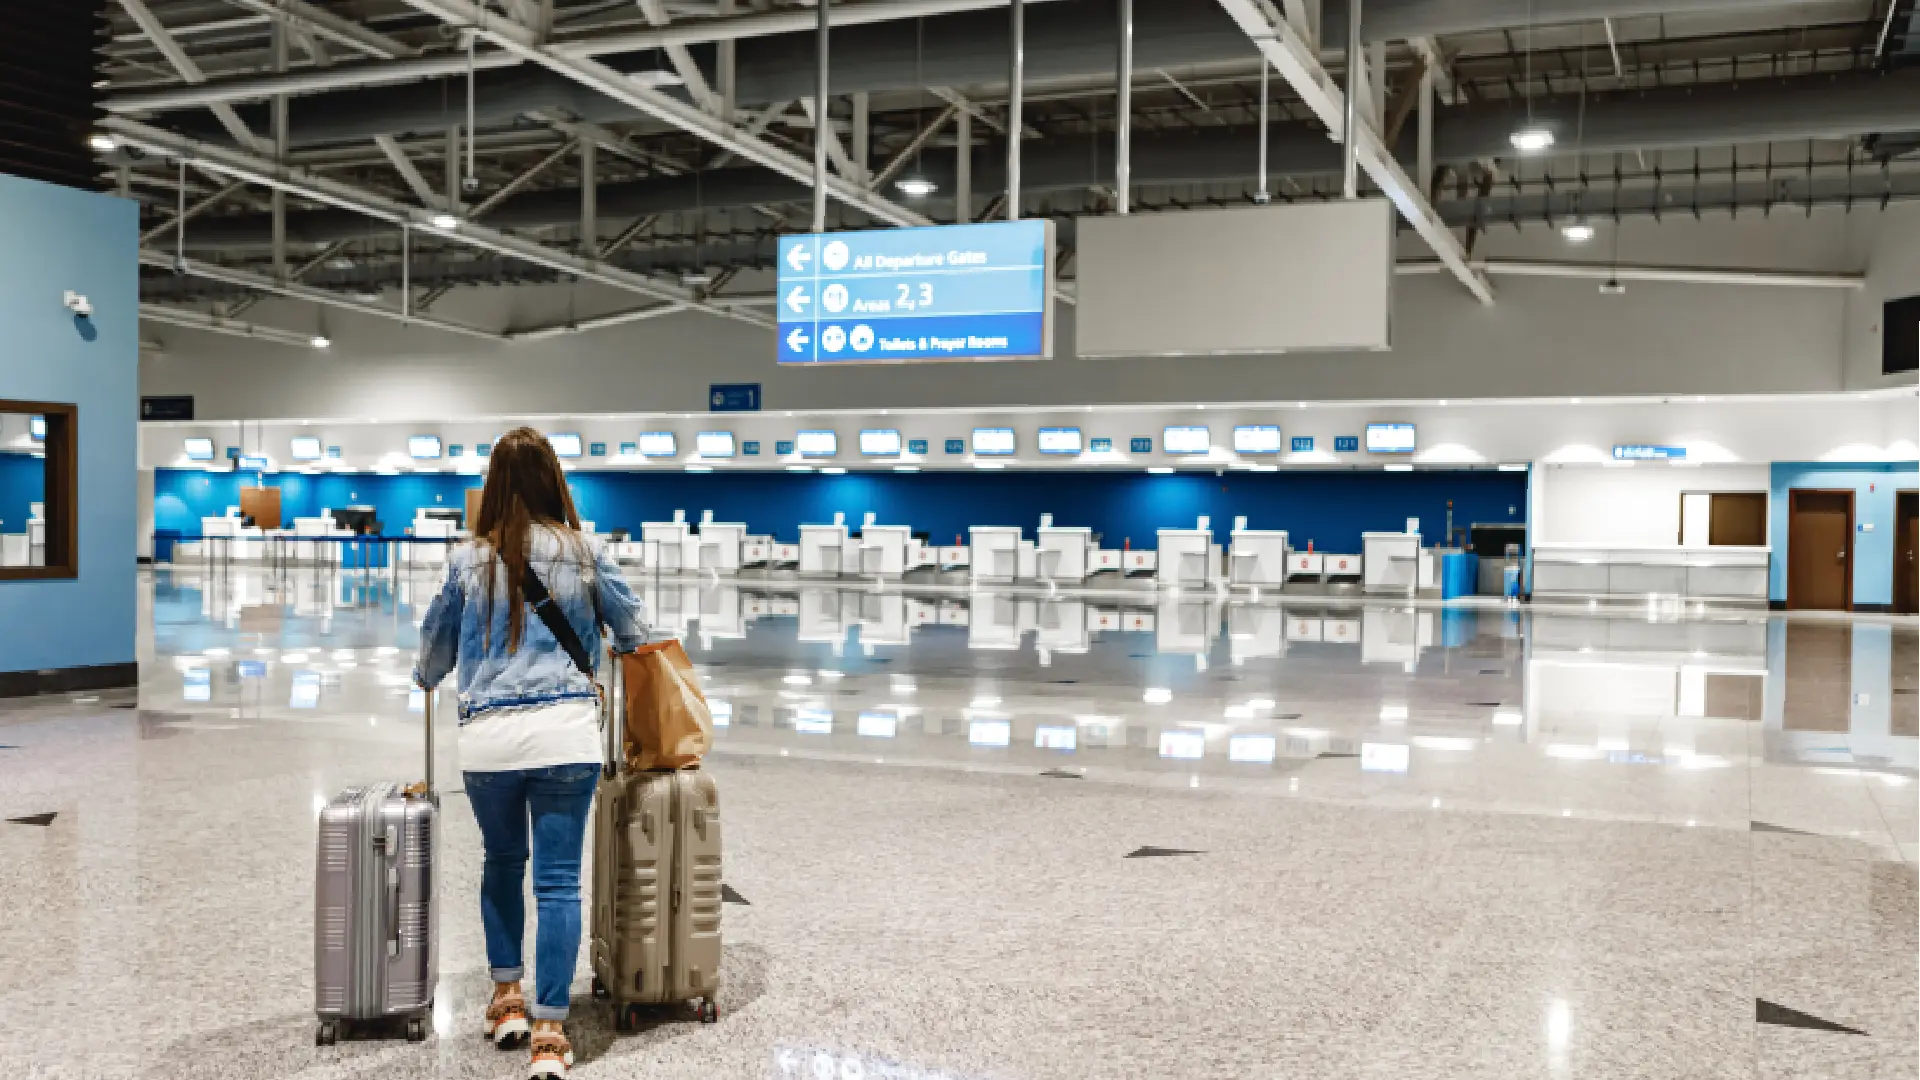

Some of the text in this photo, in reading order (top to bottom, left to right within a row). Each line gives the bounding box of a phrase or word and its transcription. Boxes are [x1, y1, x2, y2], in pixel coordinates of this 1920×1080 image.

[853, 250, 987, 272] All Departure Gates
[852, 298, 891, 312] Areas
[879, 338, 916, 351] Toilets
[930, 336, 966, 352] Prayer
[968, 336, 1008, 349] Rooms
